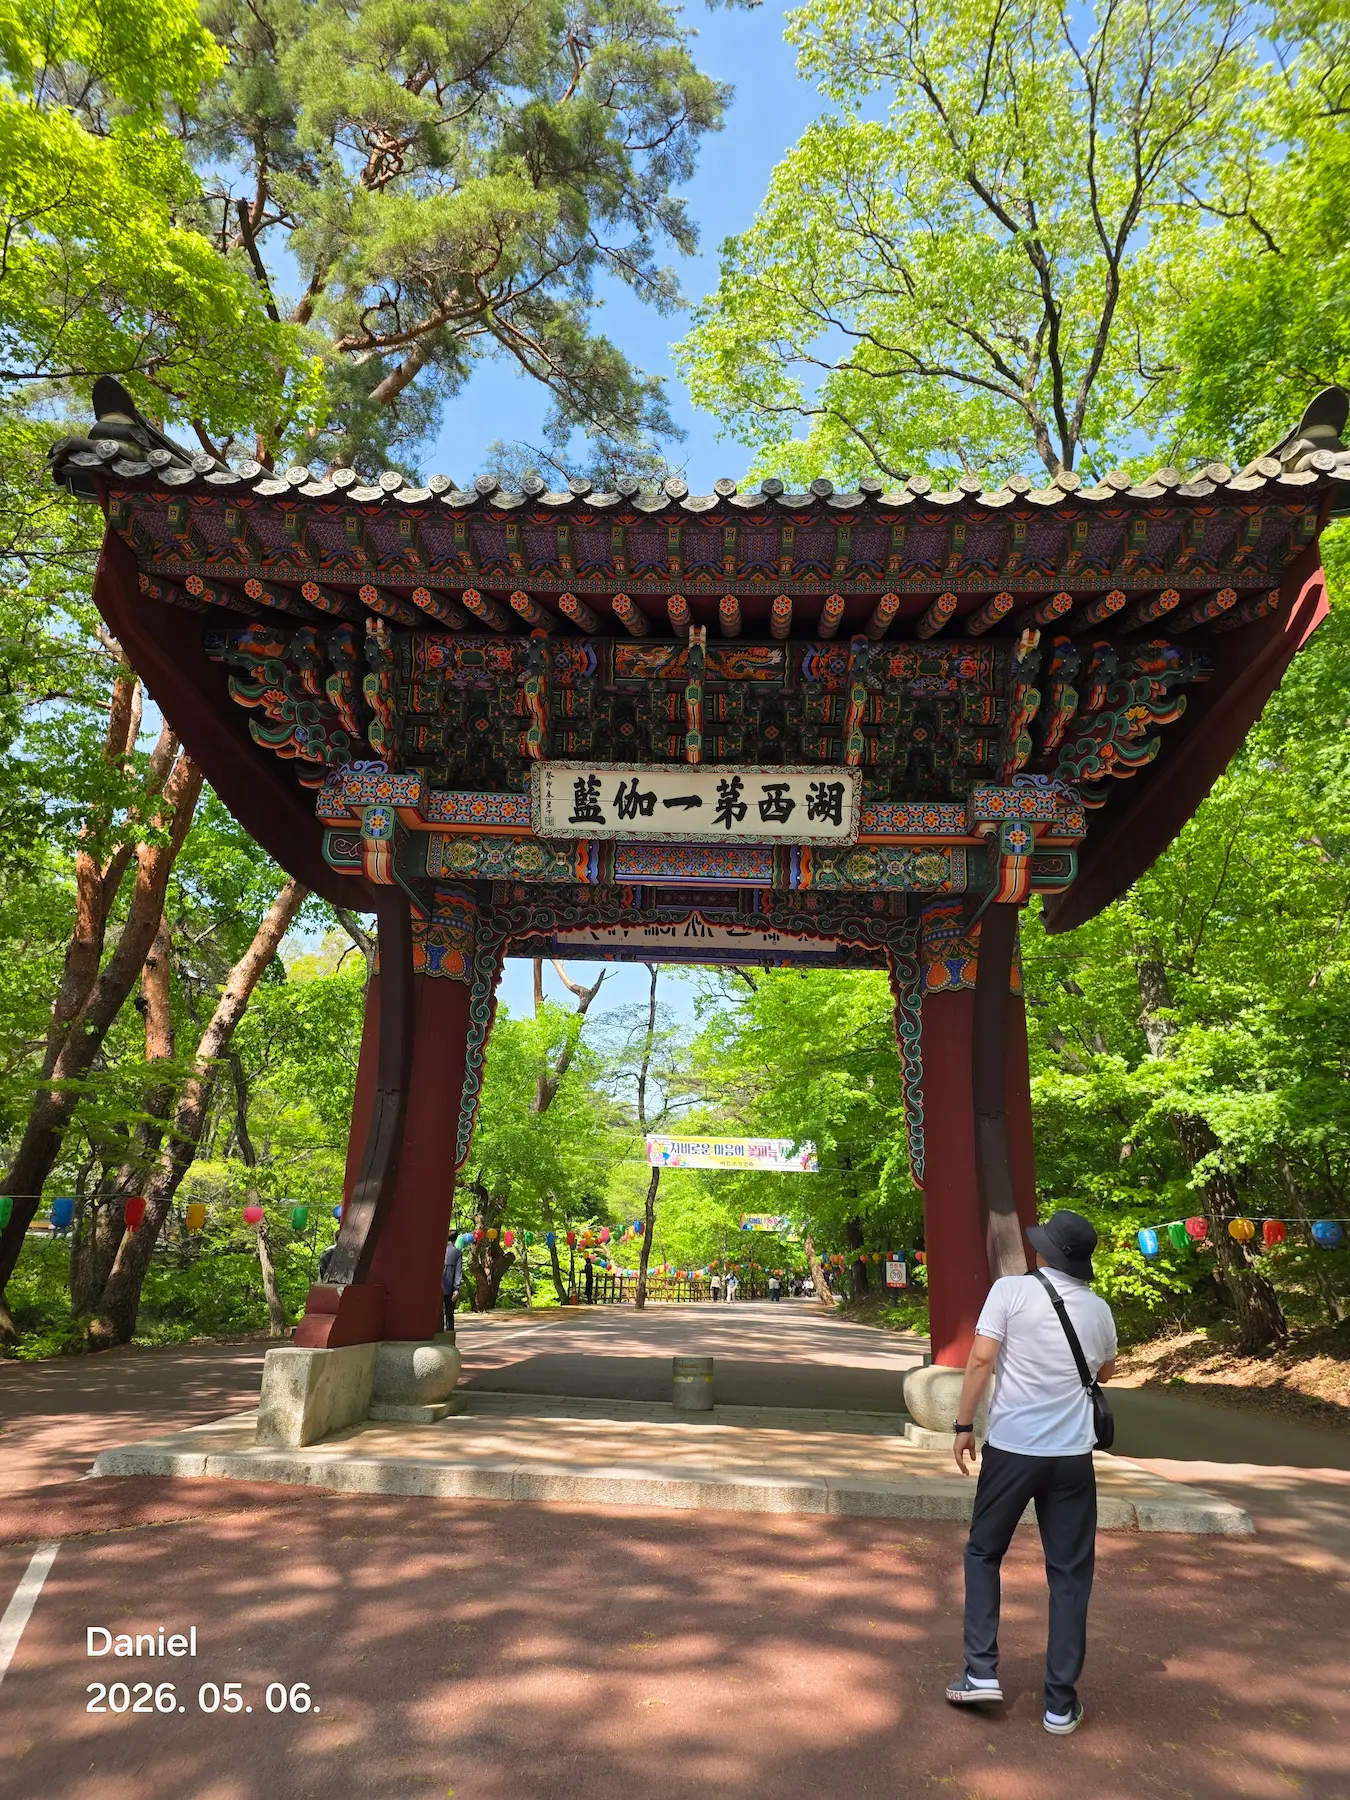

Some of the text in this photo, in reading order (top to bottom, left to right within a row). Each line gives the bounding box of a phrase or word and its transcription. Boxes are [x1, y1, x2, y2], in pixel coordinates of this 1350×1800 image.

[670, 1142, 711, 1156] 자비로운
[714, 1144, 745, 1157] 마음이
[892, 1271, 901, 1279] 30
